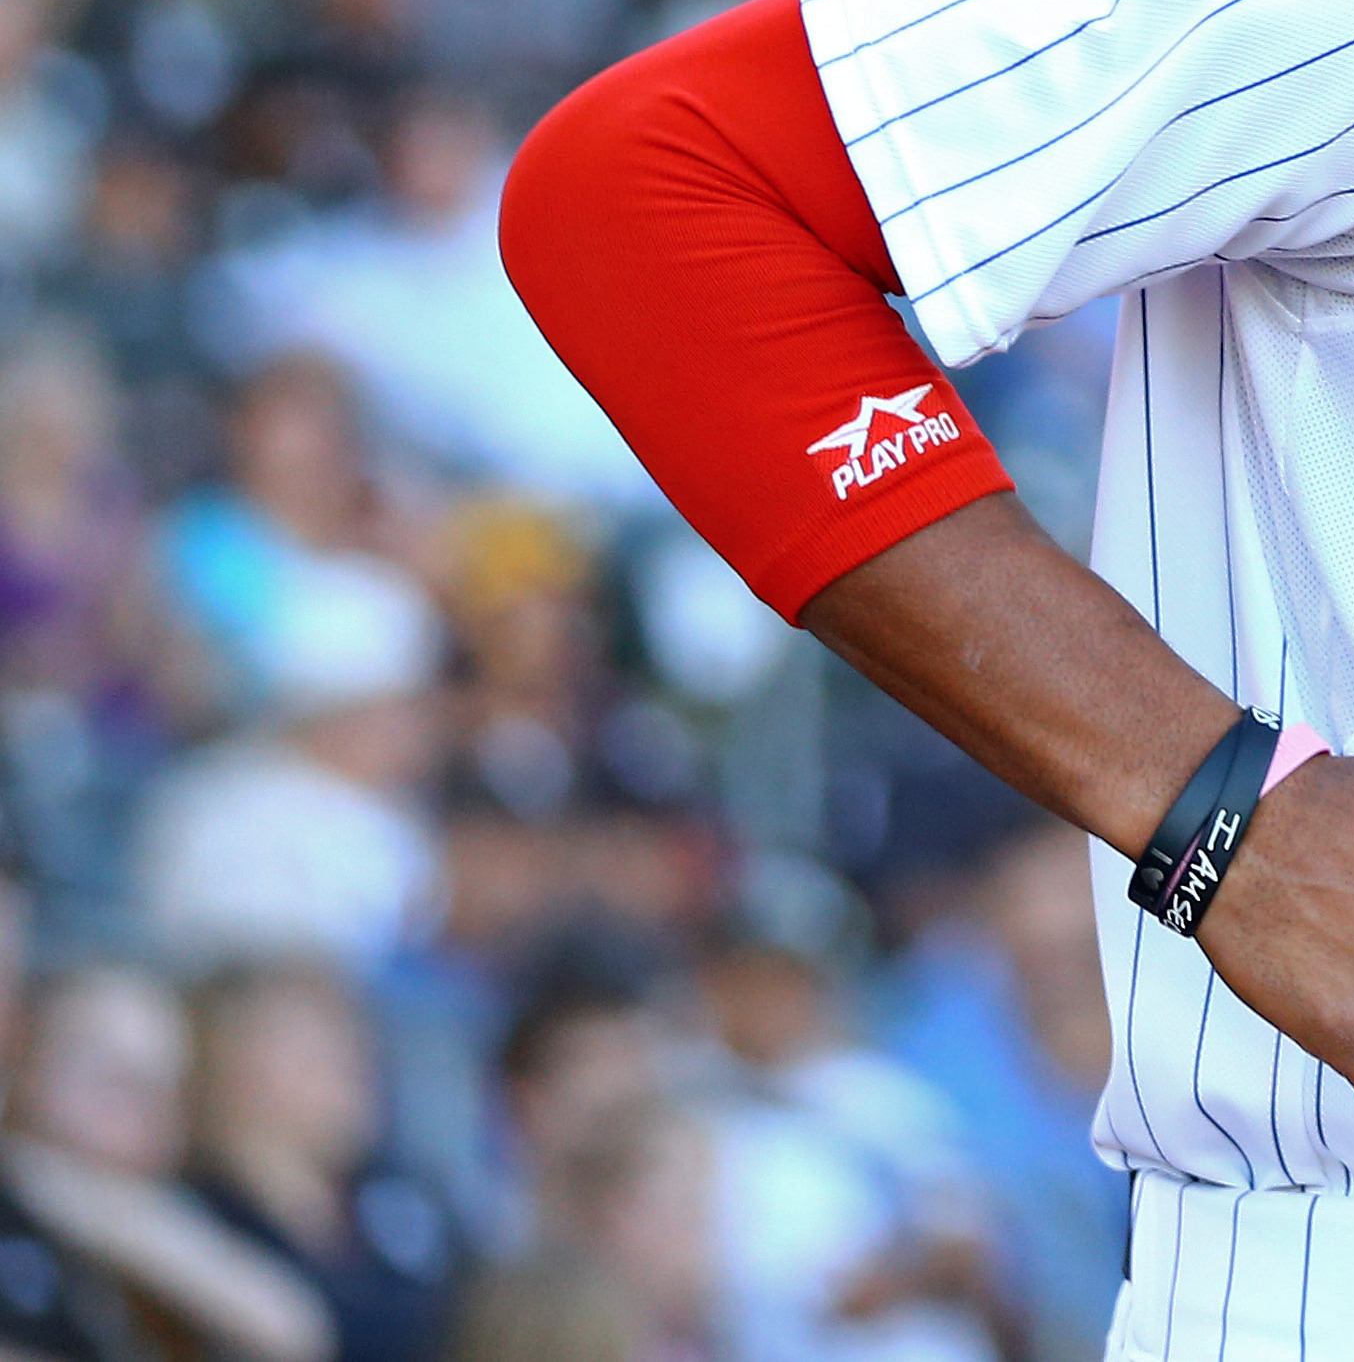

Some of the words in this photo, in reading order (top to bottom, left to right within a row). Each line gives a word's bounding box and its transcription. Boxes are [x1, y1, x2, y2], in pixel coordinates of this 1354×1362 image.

[831, 433, 907, 501] PLAY
[907, 412, 961, 455] PRO
[1206, 808, 1241, 852] I
[1180, 848, 1219, 902] AM
